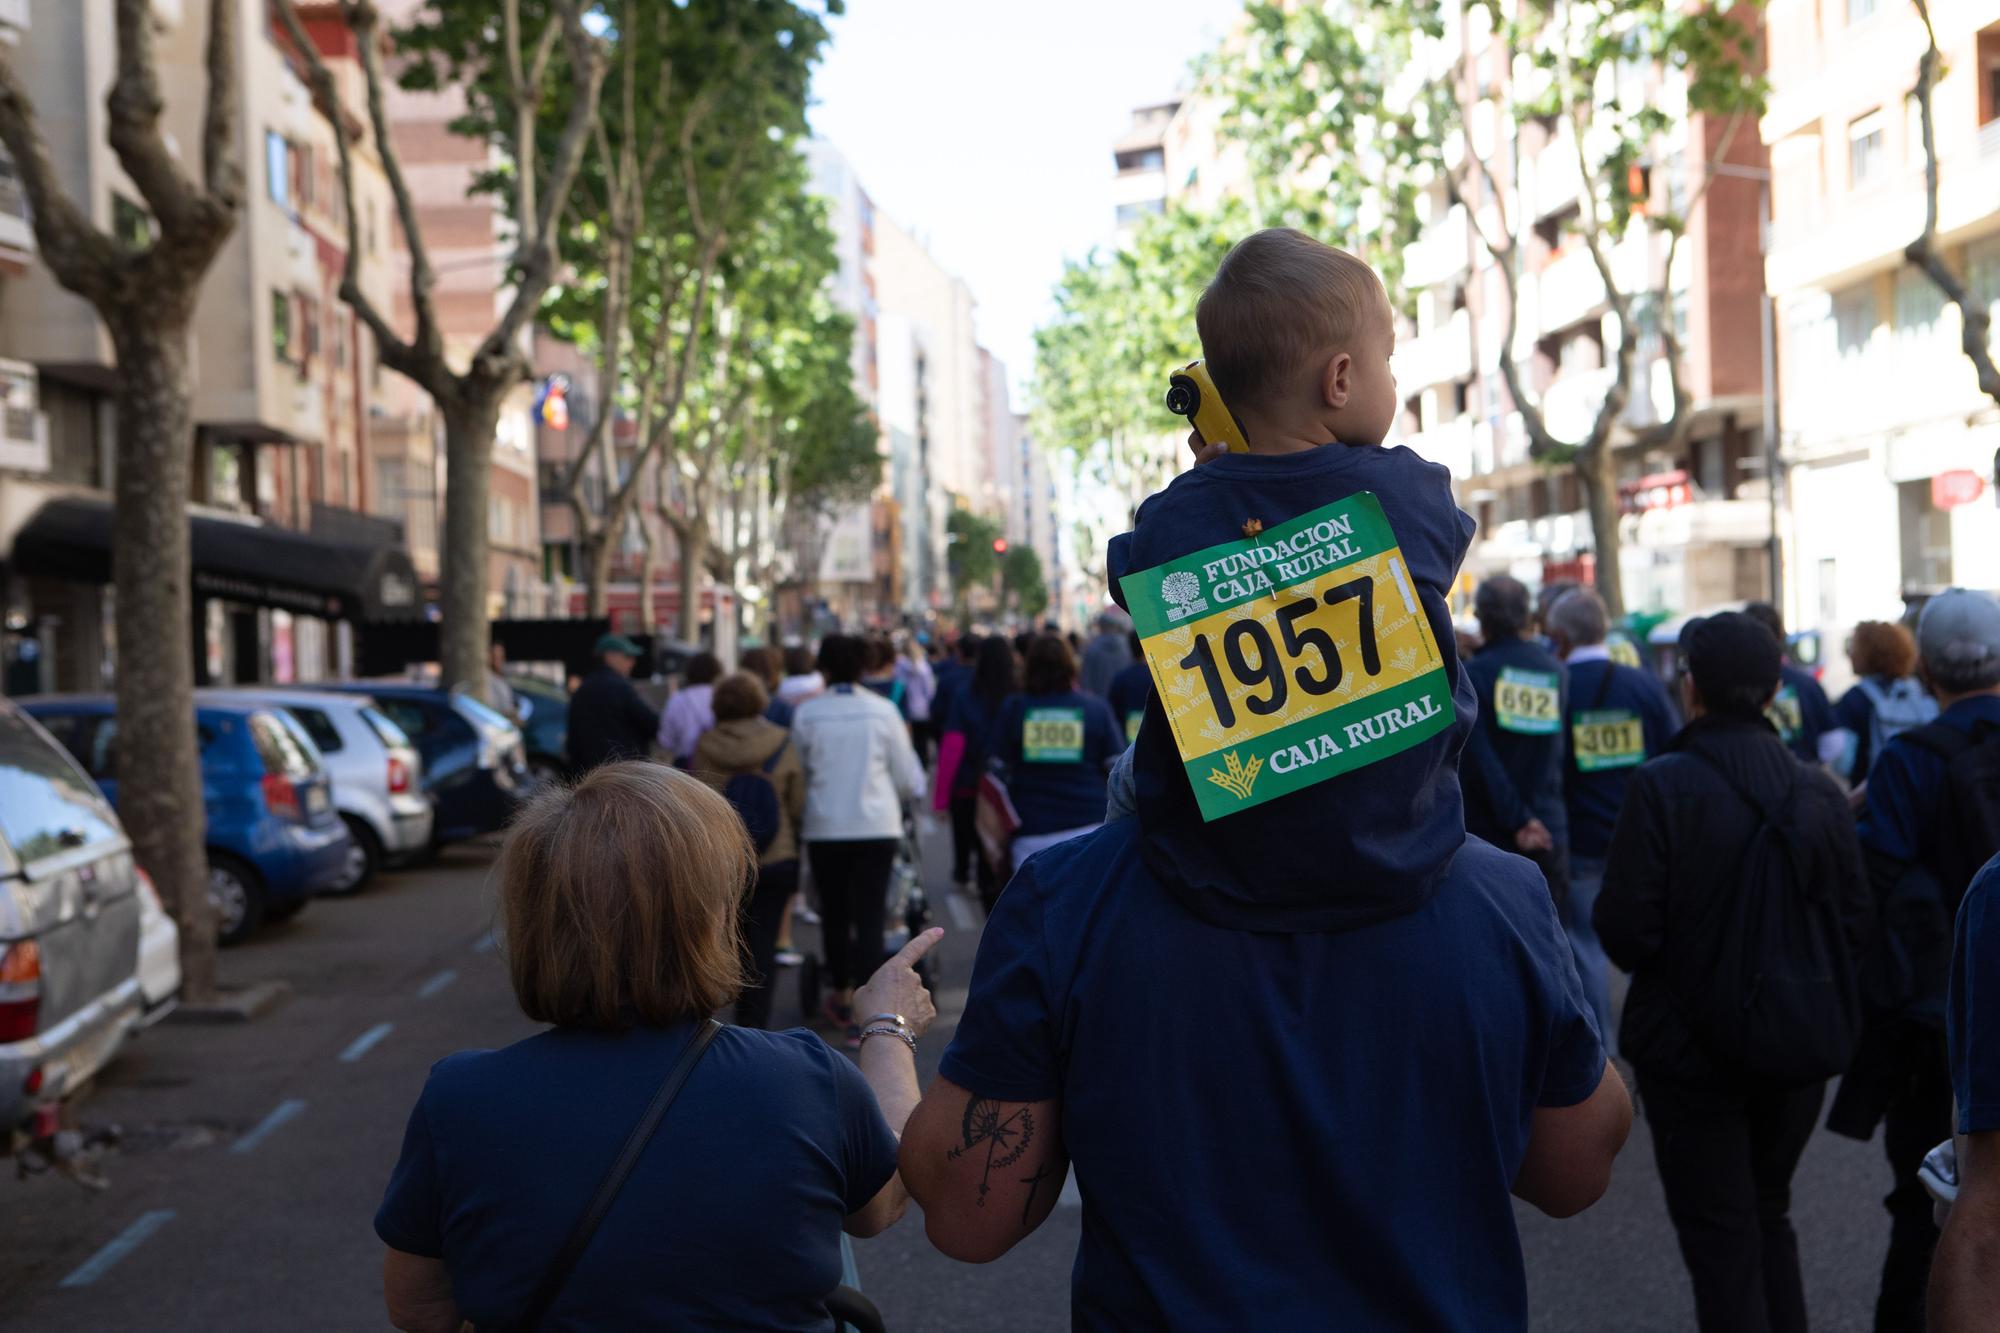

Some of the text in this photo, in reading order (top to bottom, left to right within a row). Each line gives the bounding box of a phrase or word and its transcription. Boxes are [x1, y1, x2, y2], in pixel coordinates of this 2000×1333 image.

[1202, 513, 1354, 583] FUNDACION
[1212, 538, 1361, 603] CAJA RURAL
[1179, 575, 1382, 729] 1957
[1030, 722, 1076, 745] 300
[1269, 694, 1442, 774] CAJA RURAL
[1502, 685, 1550, 718] 692
[1583, 724, 1633, 753] 301
